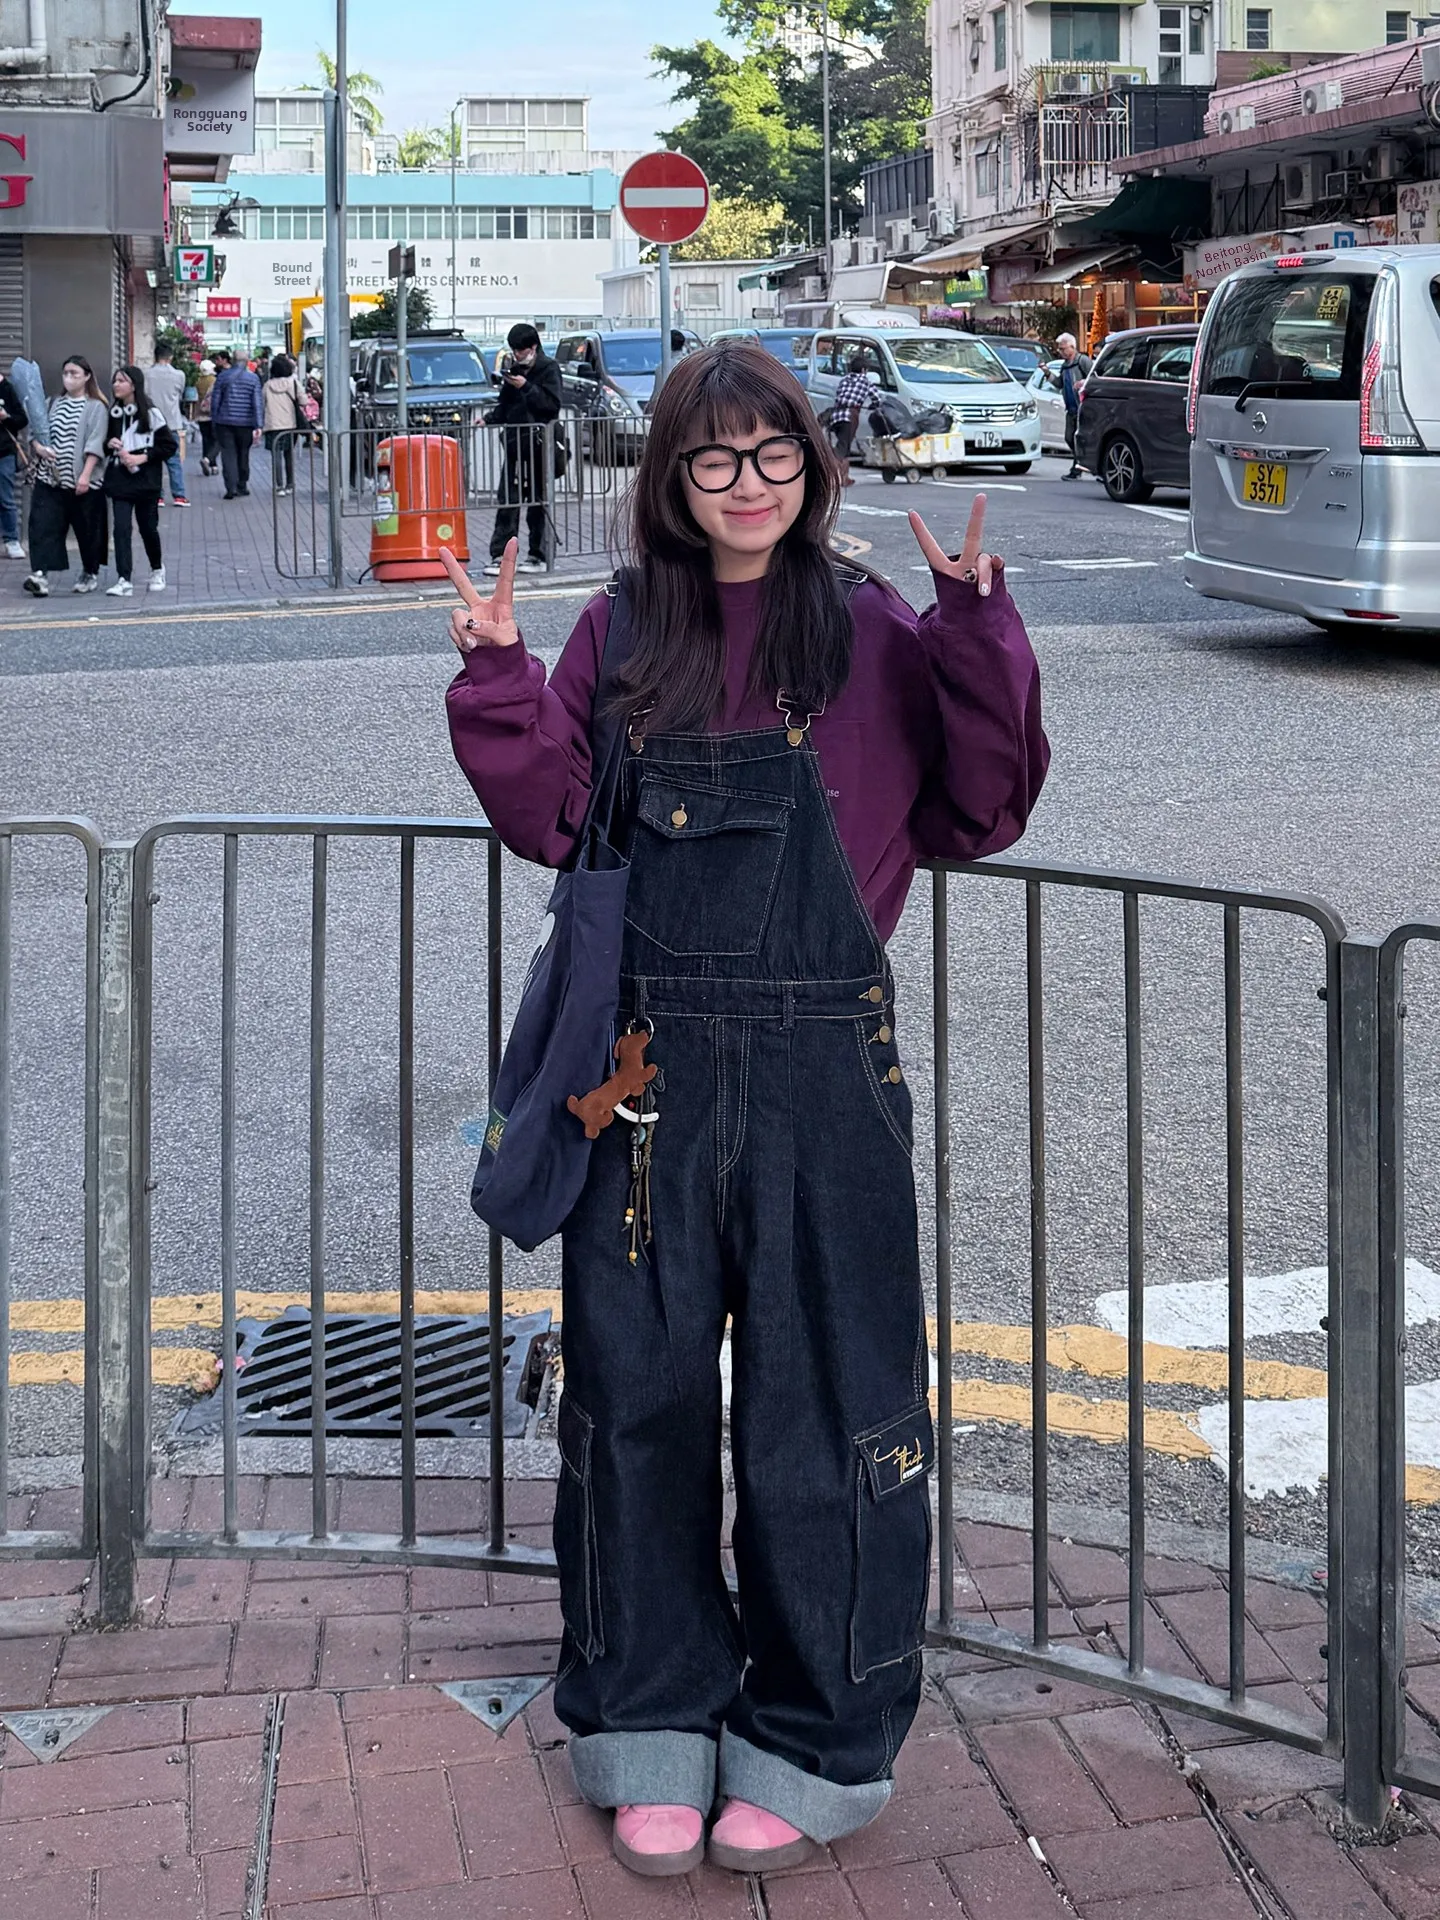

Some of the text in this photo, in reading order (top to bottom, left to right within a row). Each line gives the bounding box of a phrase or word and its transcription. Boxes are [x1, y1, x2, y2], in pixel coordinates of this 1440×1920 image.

[173, 108, 247, 121] Rongguang
[187, 120, 233, 134] Society
[1204, 242, 1251, 262] Beitong
[272, 262, 312, 273] Bound
[1196, 251, 1268, 279] North Basin
[274, 275, 311, 286] Street
[345, 275, 519, 287] TREET SRTS CENTRE NO.1
[1257, 464, 1275, 484] SY
[1250, 481, 1279, 504] 3571
